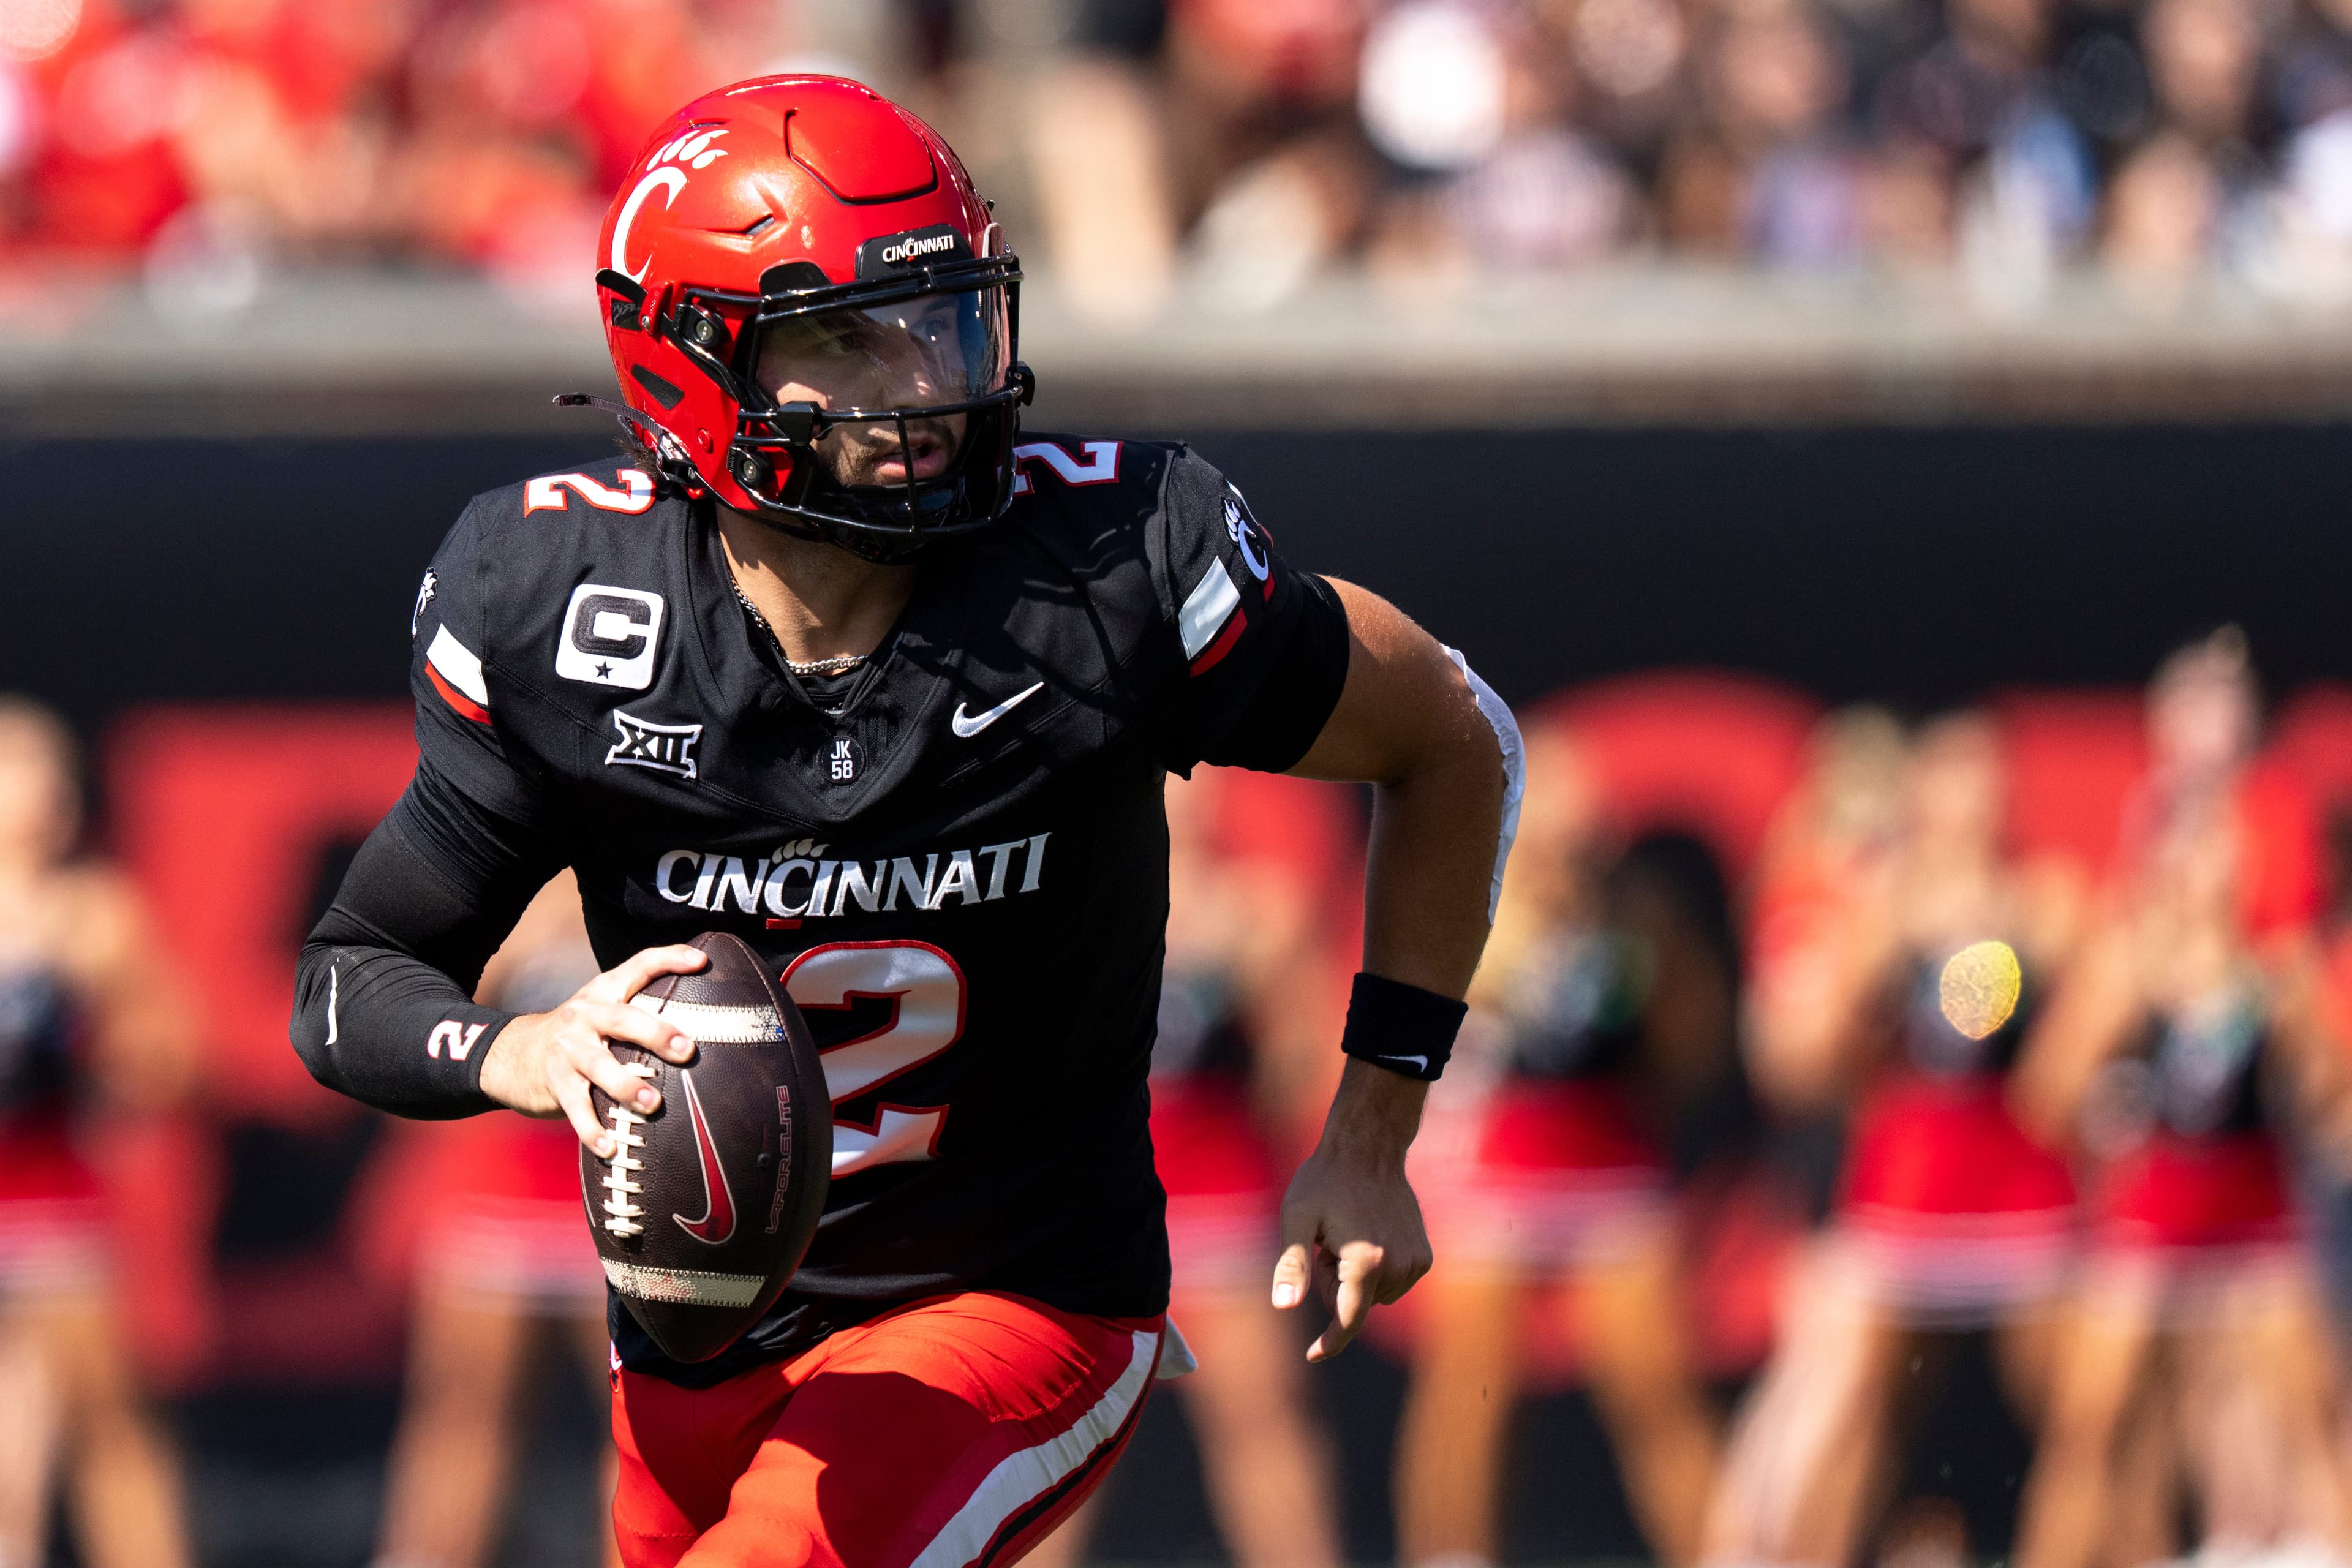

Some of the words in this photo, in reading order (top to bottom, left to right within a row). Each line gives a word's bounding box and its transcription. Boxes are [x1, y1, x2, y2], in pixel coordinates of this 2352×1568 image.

[882, 235, 954, 263] CINCINNATI
[524, 469, 655, 518] 2
[997, 440, 1124, 497] 2
[571, 594, 652, 660] C
[611, 715, 698, 772] XII
[831, 740, 851, 760] JK
[832, 760, 853, 780] 58
[656, 832, 1052, 917] CINCINNATI
[427, 1020, 489, 1061] 2
[780, 940, 967, 1180] 2
[776, 1085, 792, 1155] ELITE
[765, 1155, 791, 1234] VAPOR
